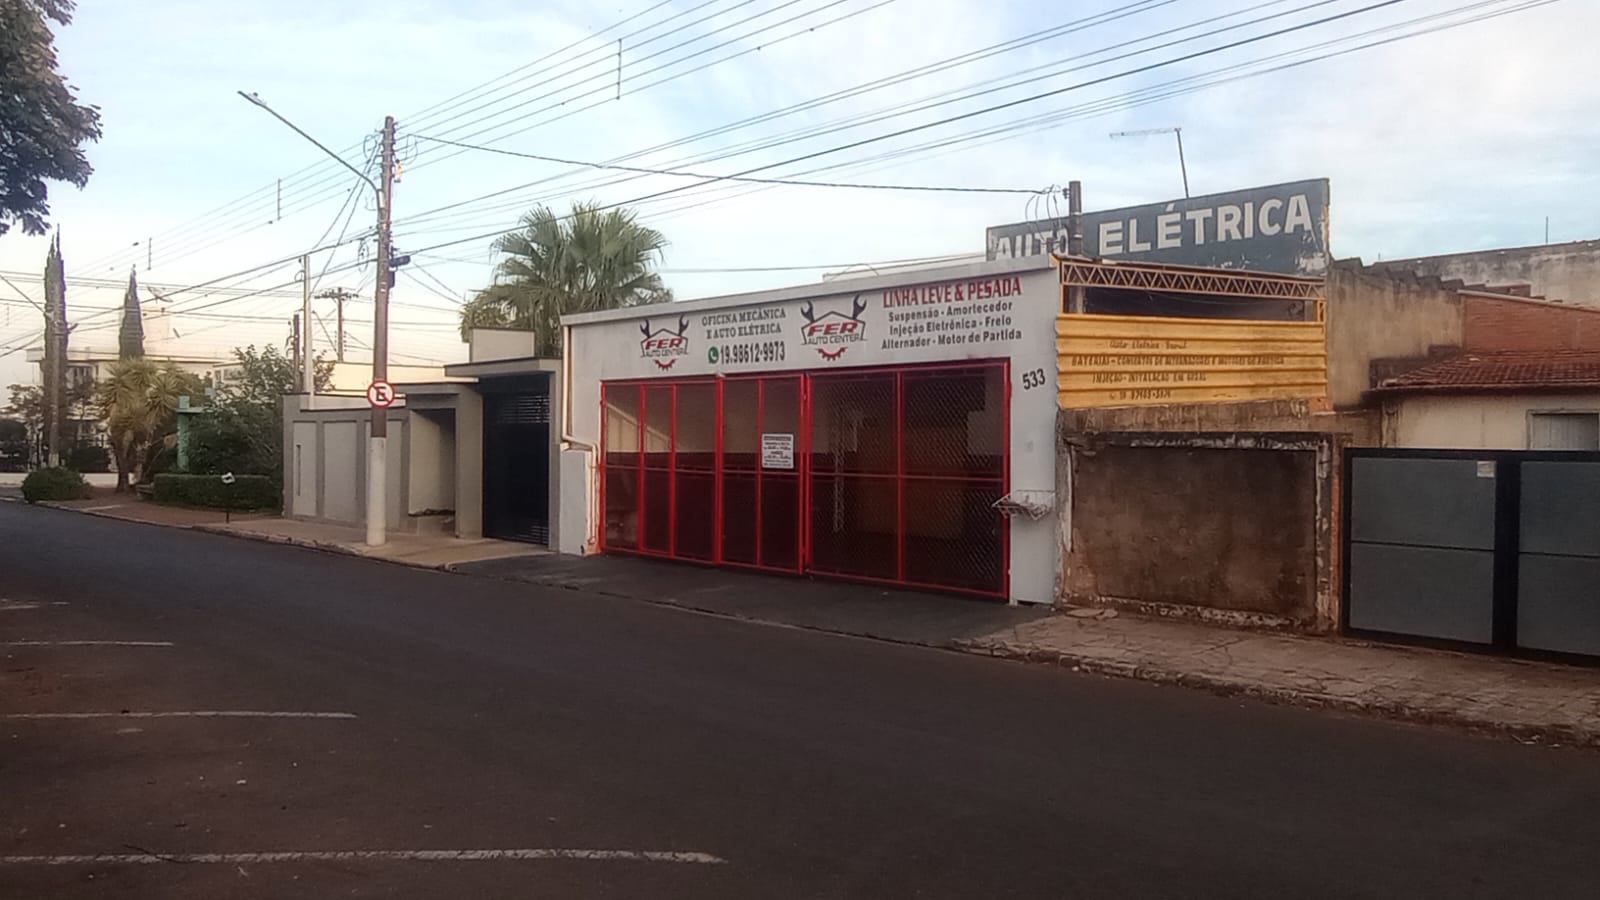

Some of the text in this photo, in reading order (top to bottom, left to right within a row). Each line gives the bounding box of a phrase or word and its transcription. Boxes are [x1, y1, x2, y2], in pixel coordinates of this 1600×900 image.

[1099, 194, 1314, 255] ELÉTRICA
[883, 277, 1022, 308] LINHA LEVE & PESADA
[701, 307, 786, 327] OFICINA MECÂNICA
[888, 307, 939, 323] Suspensão
[946, 301, 1012, 316] Amortecedor
[713, 327, 736, 339] AUTO
[738, 322, 782, 336] ELÉTRICA
[807, 321, 858, 337] FER
[889, 322, 924, 337] Injeção
[926, 318, 977, 333] Eletrônica
[985, 315, 1012, 328] Freio
[645, 336, 683, 350] FER
[808, 333, 860, 346] AUTO CENTER
[881, 337, 930, 350] Alternador
[938, 333, 966, 345] Motor
[968, 331, 980, 343] de
[983, 328, 1022, 342] Partida
[1022, 368, 1046, 390] 533
